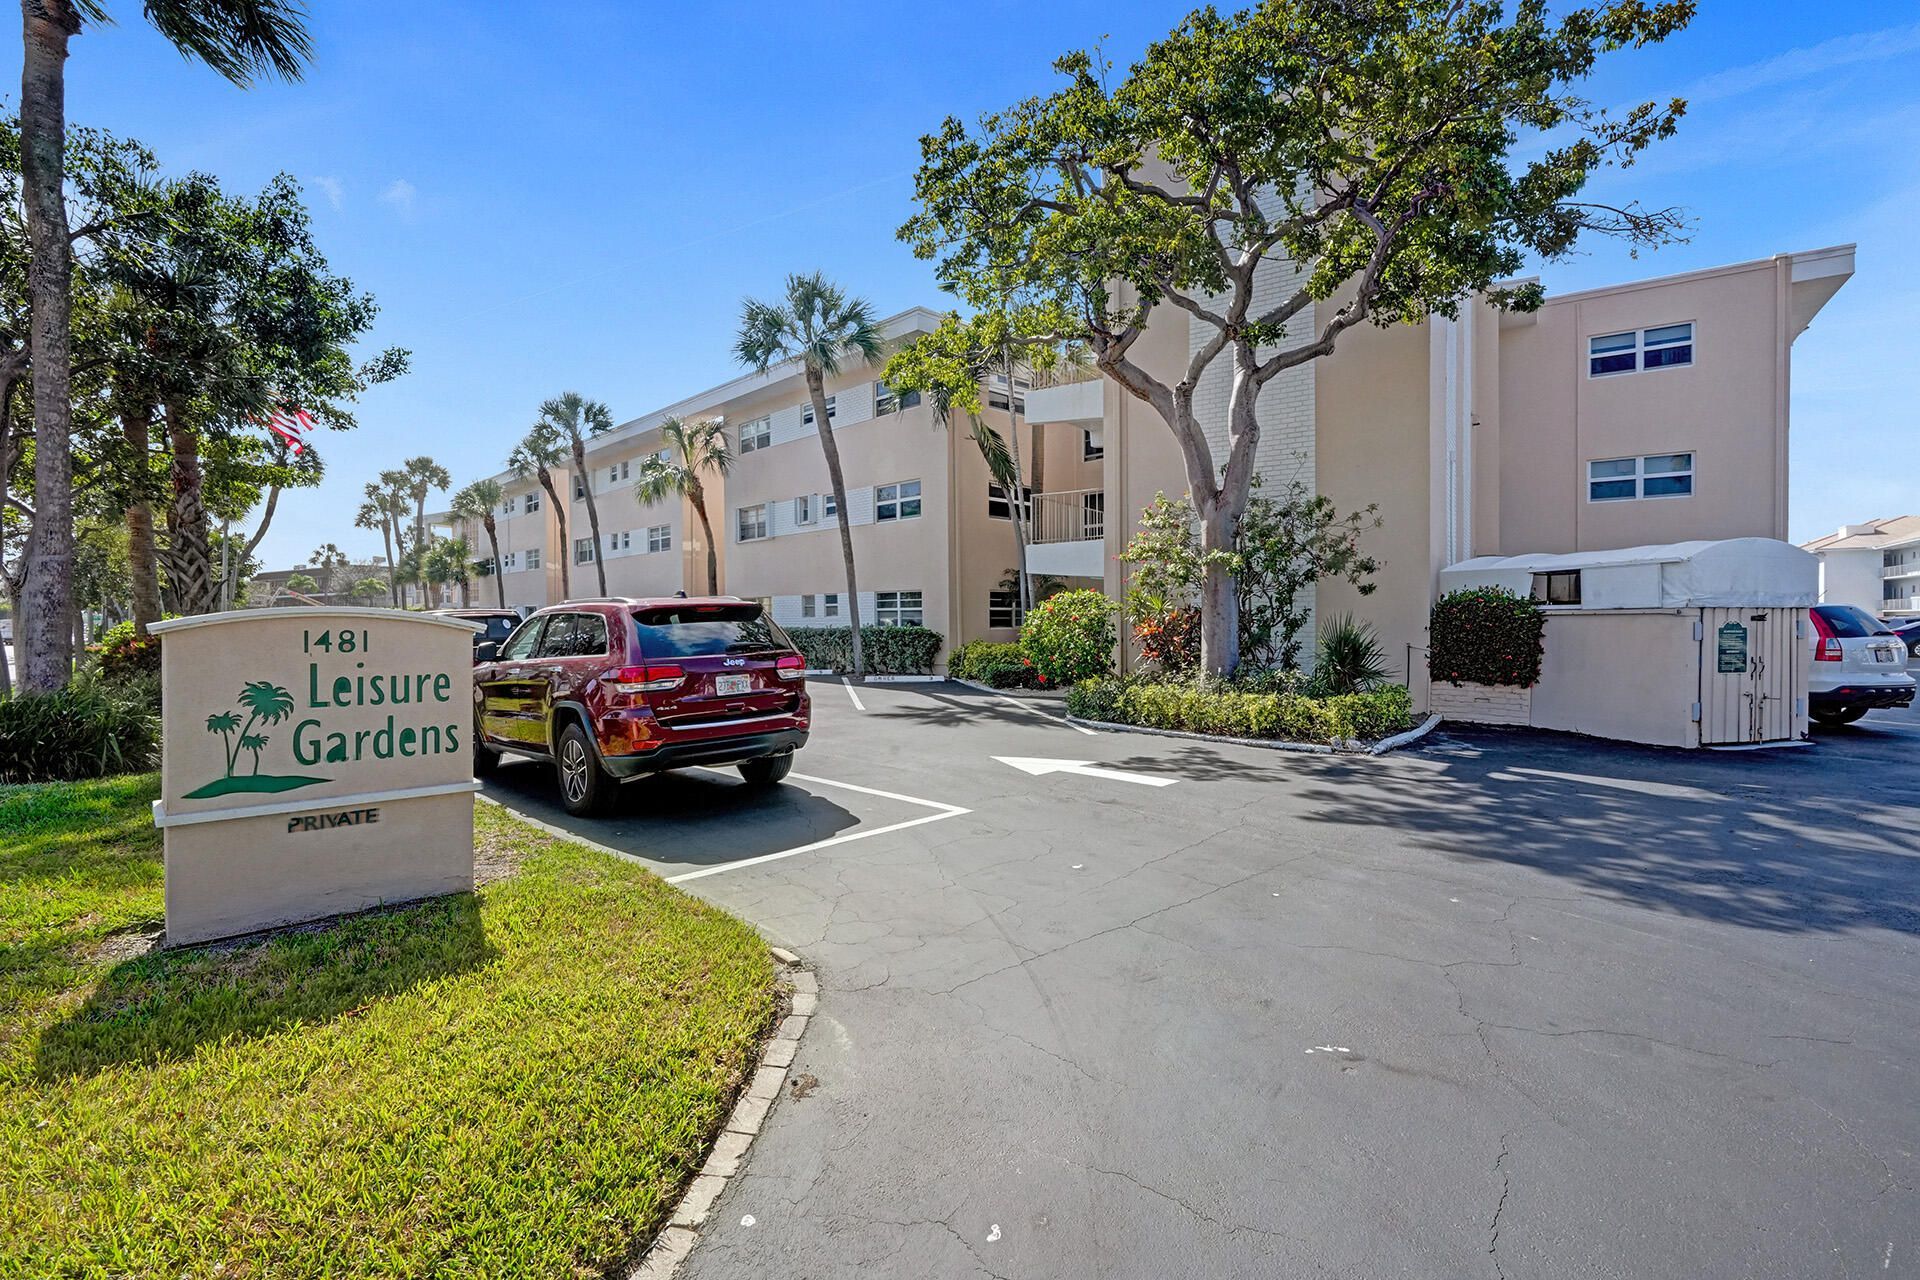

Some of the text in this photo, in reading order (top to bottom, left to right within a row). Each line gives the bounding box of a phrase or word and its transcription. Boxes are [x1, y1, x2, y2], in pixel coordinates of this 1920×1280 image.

[303, 629, 368, 654] 1481
[723, 658, 746, 667] Jeep
[308, 662, 451, 708] Leisure
[292, 715, 459, 766] Gardens
[288, 808, 379, 833] PRIVATE
